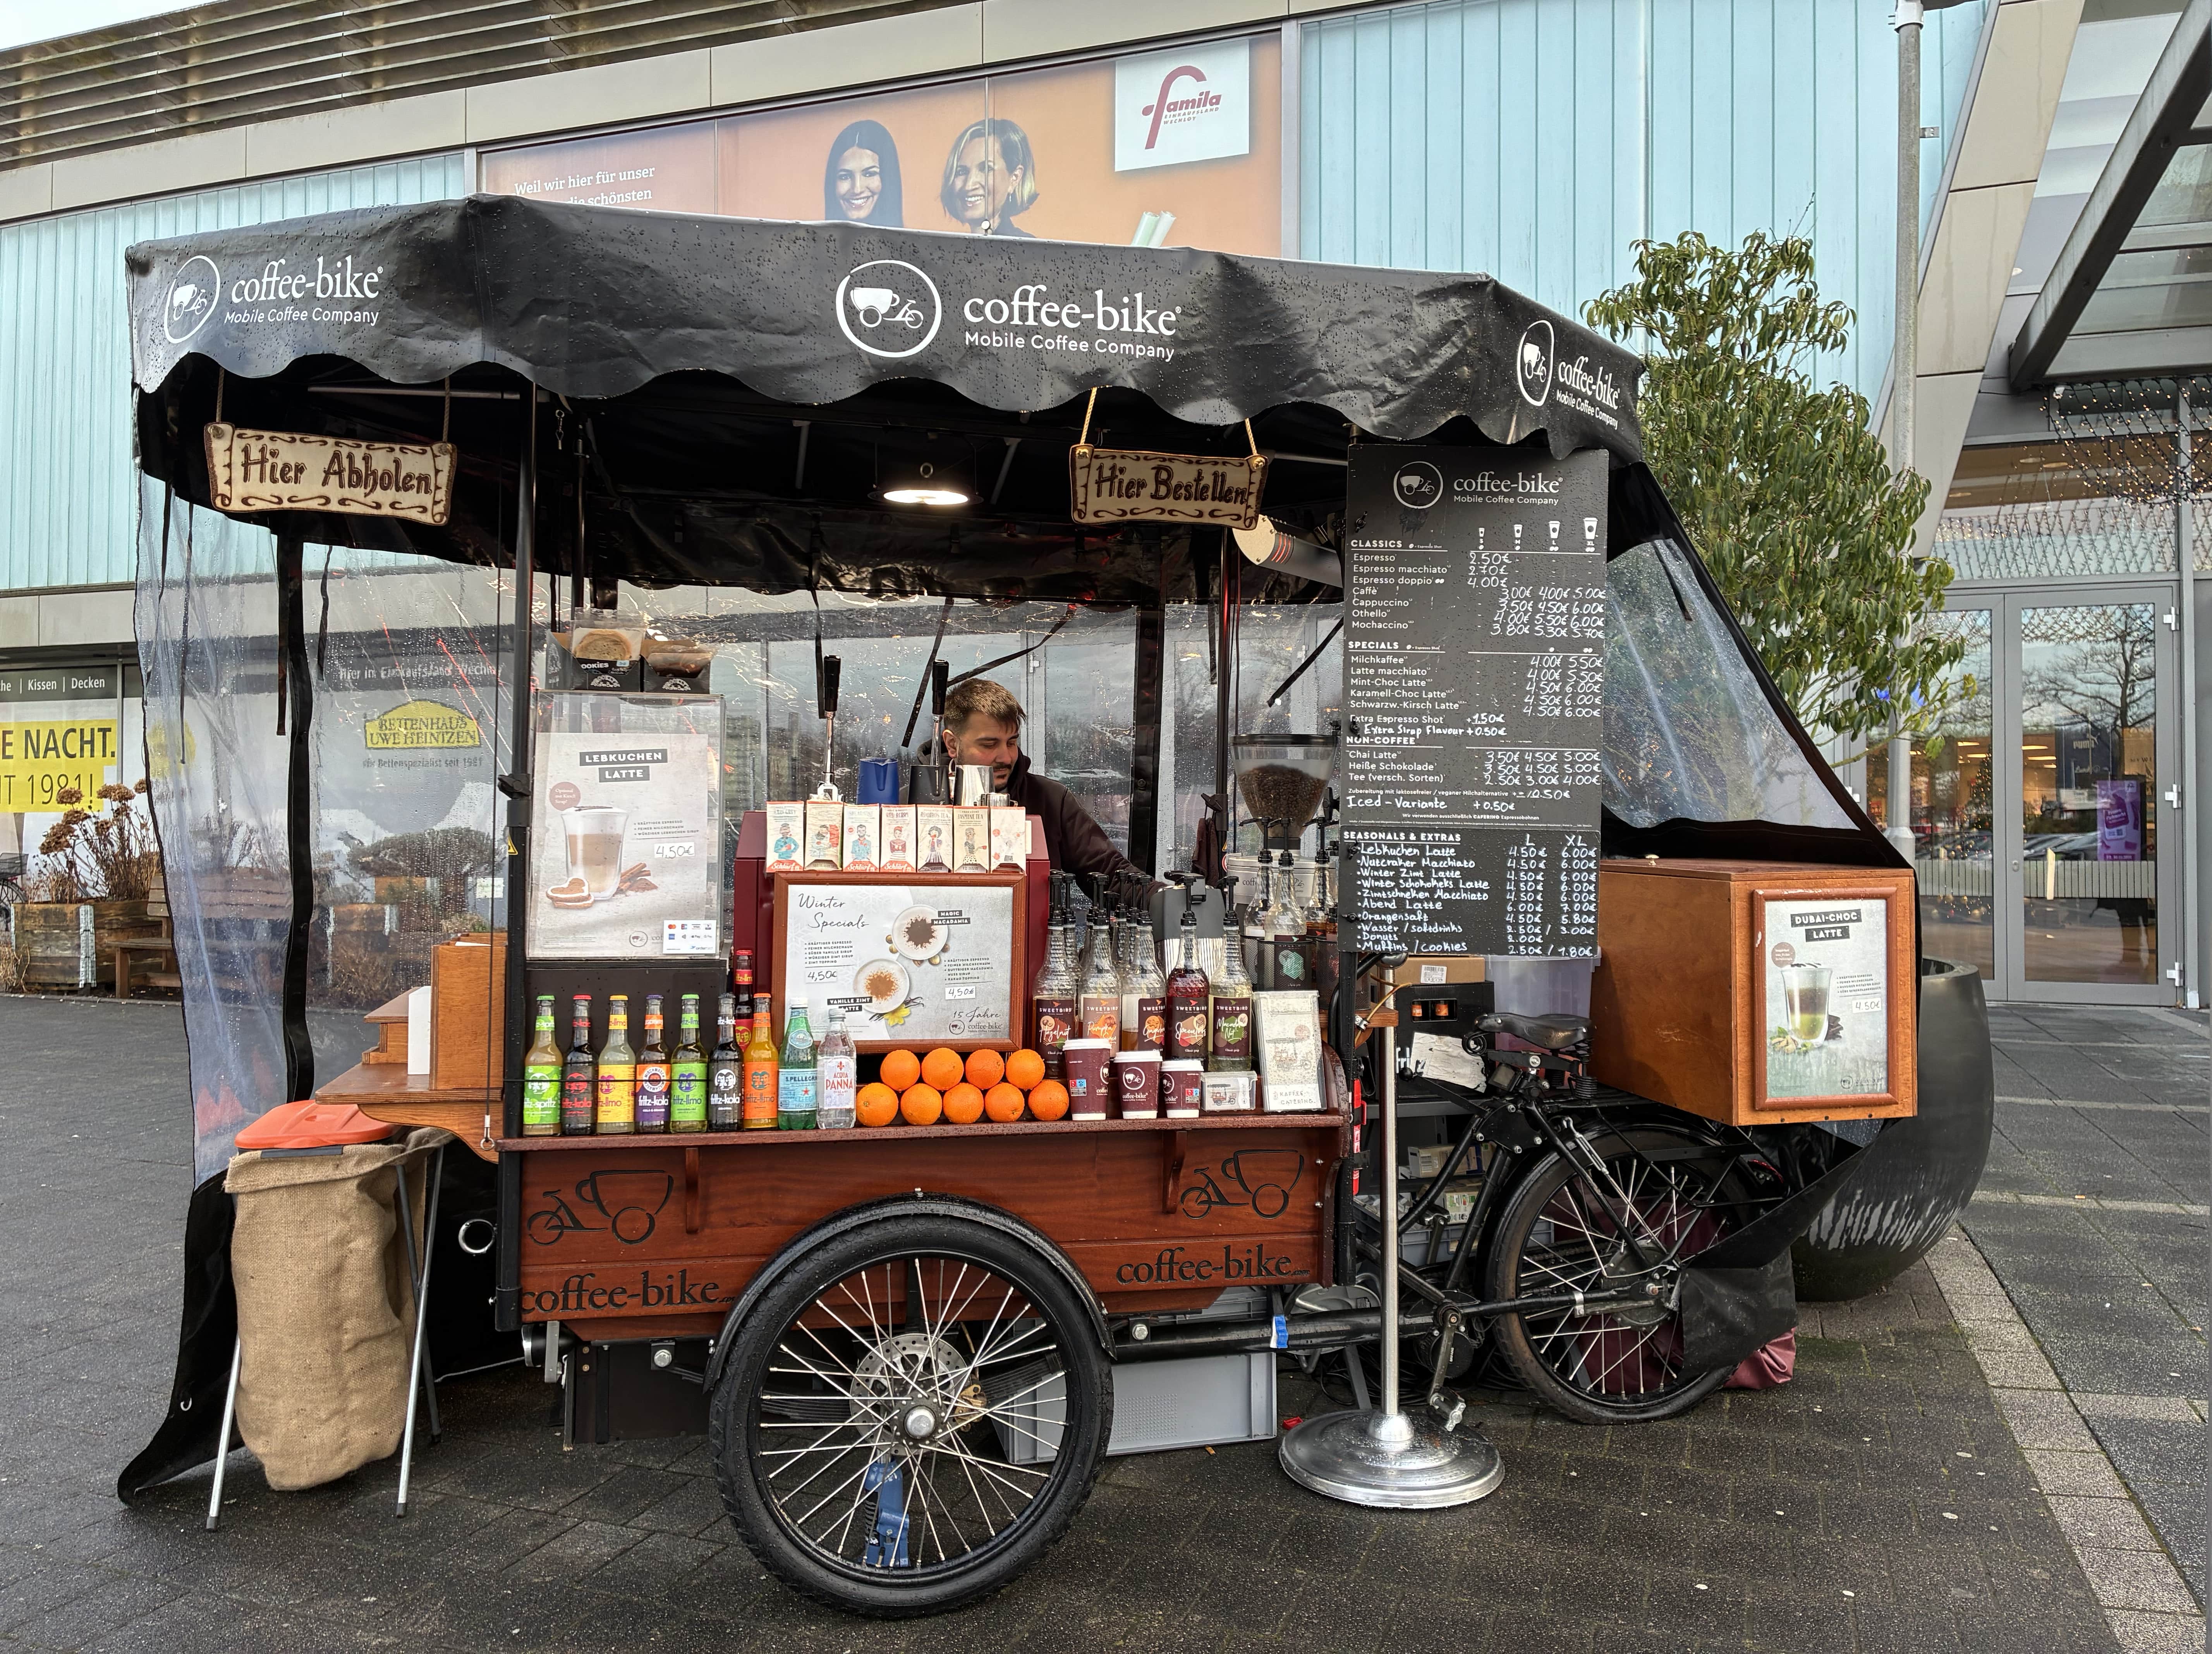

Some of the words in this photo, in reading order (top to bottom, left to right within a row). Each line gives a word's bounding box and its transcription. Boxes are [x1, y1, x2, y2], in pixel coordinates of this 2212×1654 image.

[1142, 65, 1222, 149] famila
[1164, 107, 1219, 119] EINKAUFSLAND
[1163, 117, 1196, 125] WECHLOY
[514, 180, 541, 194] Weil
[544, 178, 565, 190] wir
[568, 175, 593, 188] hier
[596, 171, 615, 184] für
[619, 167, 655, 181] unser
[588, 189, 652, 206] schönsten
[224, 309, 264, 324] Mobile
[268, 306, 308, 321] Coffee
[312, 307, 379, 326] Company
[965, 331, 1025, 348] Mobile
[1031, 335, 1089, 352] Coffee
[1095, 339, 1175, 362] Company
[1556, 389, 1575, 407] Mobile
[1577, 398, 1594, 415] Coffee
[1595, 407, 1618, 430] Company
[241, 444, 307, 484] Hier
[321, 450, 432, 498] Abholen
[1095, 463, 1147, 499] Hier
[1150, 465, 1247, 505] Bestellen
[1517, 496, 1559, 506] Company
[1470, 552, 1512, 565] 2.50€
[1353, 564, 1395, 574] Espresso
[1468, 565, 1508, 575] 2.70€
[1353, 576, 1395, 585] Espresso
[1467, 576, 1508, 589] 4.00€
[1499, 587, 1533, 600] 3.00€
[1573, 587, 1606, 599] 5.00€
[1496, 600, 1534, 613] 3.50€
[1538, 601, 1570, 613] 4.50€
[1572, 602, 1604, 614] 6.00€
[1348, 641, 1399, 649] SPECIALS
[1531, 655, 1563, 668] 4.00€
[1569, 656, 1603, 669] 5.50€
[28, 679, 57, 691] Kissen
[71, 676, 105, 689] Decken
[1351, 689, 1419, 697] Karamell-Choc
[1350, 700, 1432, 709] Schwarzw.-Kirsch
[1364, 723, 1395, 735] Extra
[1398, 725, 1422, 739] Sirup
[1426, 725, 1464, 735] Flavour
[24, 727, 115, 760] NACHT.
[370, 733, 401, 745] UWE
[1346, 736, 1415, 745] NON-COFFEE
[585, 752, 662, 763] LEBKUCHEN
[605, 770, 644, 779] LATTE
[1369, 774, 1405, 782] (versch.
[1485, 775, 1521, 786] 2.50€
[1526, 775, 1559, 786] 3.00€
[1563, 775, 1601, 786] 4.00€
[1346, 795, 1381, 808] Iced
[1395, 796, 1447, 809] Variante
[1344, 832, 1405, 841] SEASONALS
[1421, 833, 1461, 841] EXTRAS
[1526, 834, 1535, 846] L
[1565, 834, 1587, 846] XL
[1426, 845, 1456, 856] Latte
[1509, 846, 1547, 858] 4.50€
[1562, 847, 1597, 858] 6.00€
[1360, 867, 1395, 877] Winter
[1400, 868, 1424, 877] Zimt
[1432, 868, 1462, 878] Latte
[799, 893, 846, 908] Winter
[1362, 899, 1397, 909] Abend
[1406, 901, 1443, 909] Latte
[1507, 902, 1543, 912] 6.00€
[1560, 903, 1597, 913] 7.00€
[808, 912, 870, 932] Specials
[1362, 911, 1429, 923] Orangensaft
[1506, 914, 1541, 923] 4.50€
[1561, 913, 1595, 924] 5.80€
[1795, 912, 1858, 924] DUBAI-CHOC
[1363, 932, 1398, 940] Donuts
[1813, 929, 1842, 939] LATTE
[1039, 1025, 1071, 1043] Hazelnut
[826, 1079, 853, 1090] PANNA
